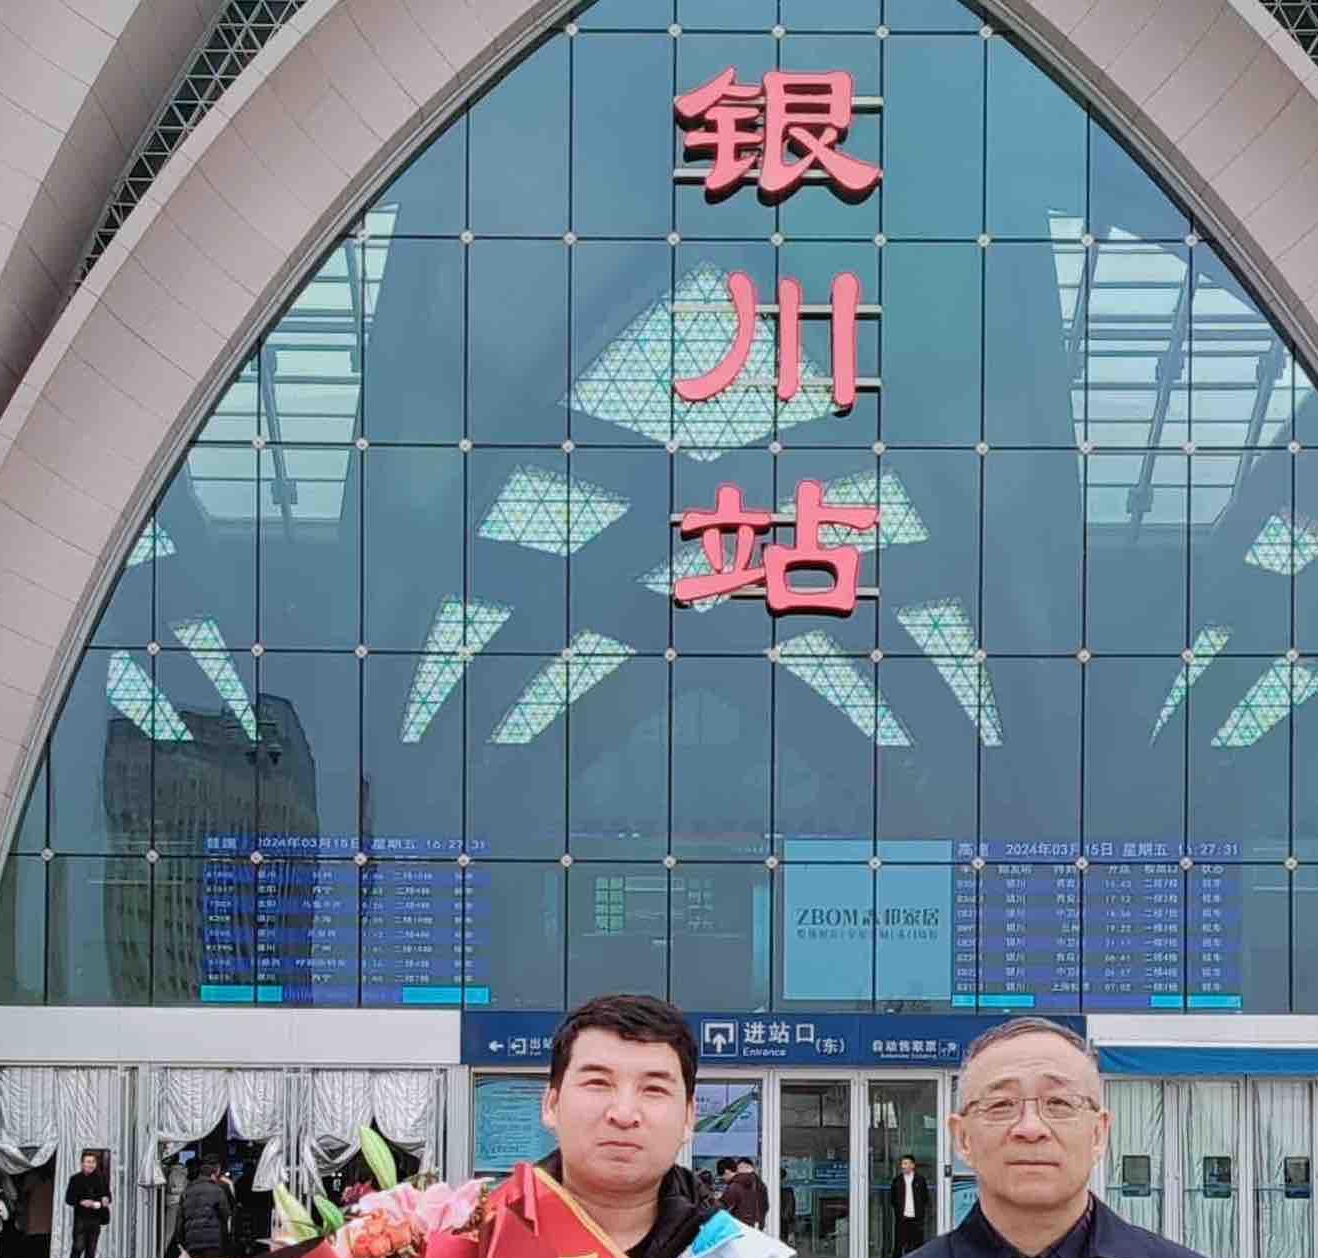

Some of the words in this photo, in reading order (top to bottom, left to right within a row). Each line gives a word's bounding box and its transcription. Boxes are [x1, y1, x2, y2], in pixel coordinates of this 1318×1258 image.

[673, 65, 883, 618] 银川站
[795, 907, 858, 927] ZBOM
[743, 1020, 816, 1044] 进站口
[743, 1046, 788, 1057] Entrance
